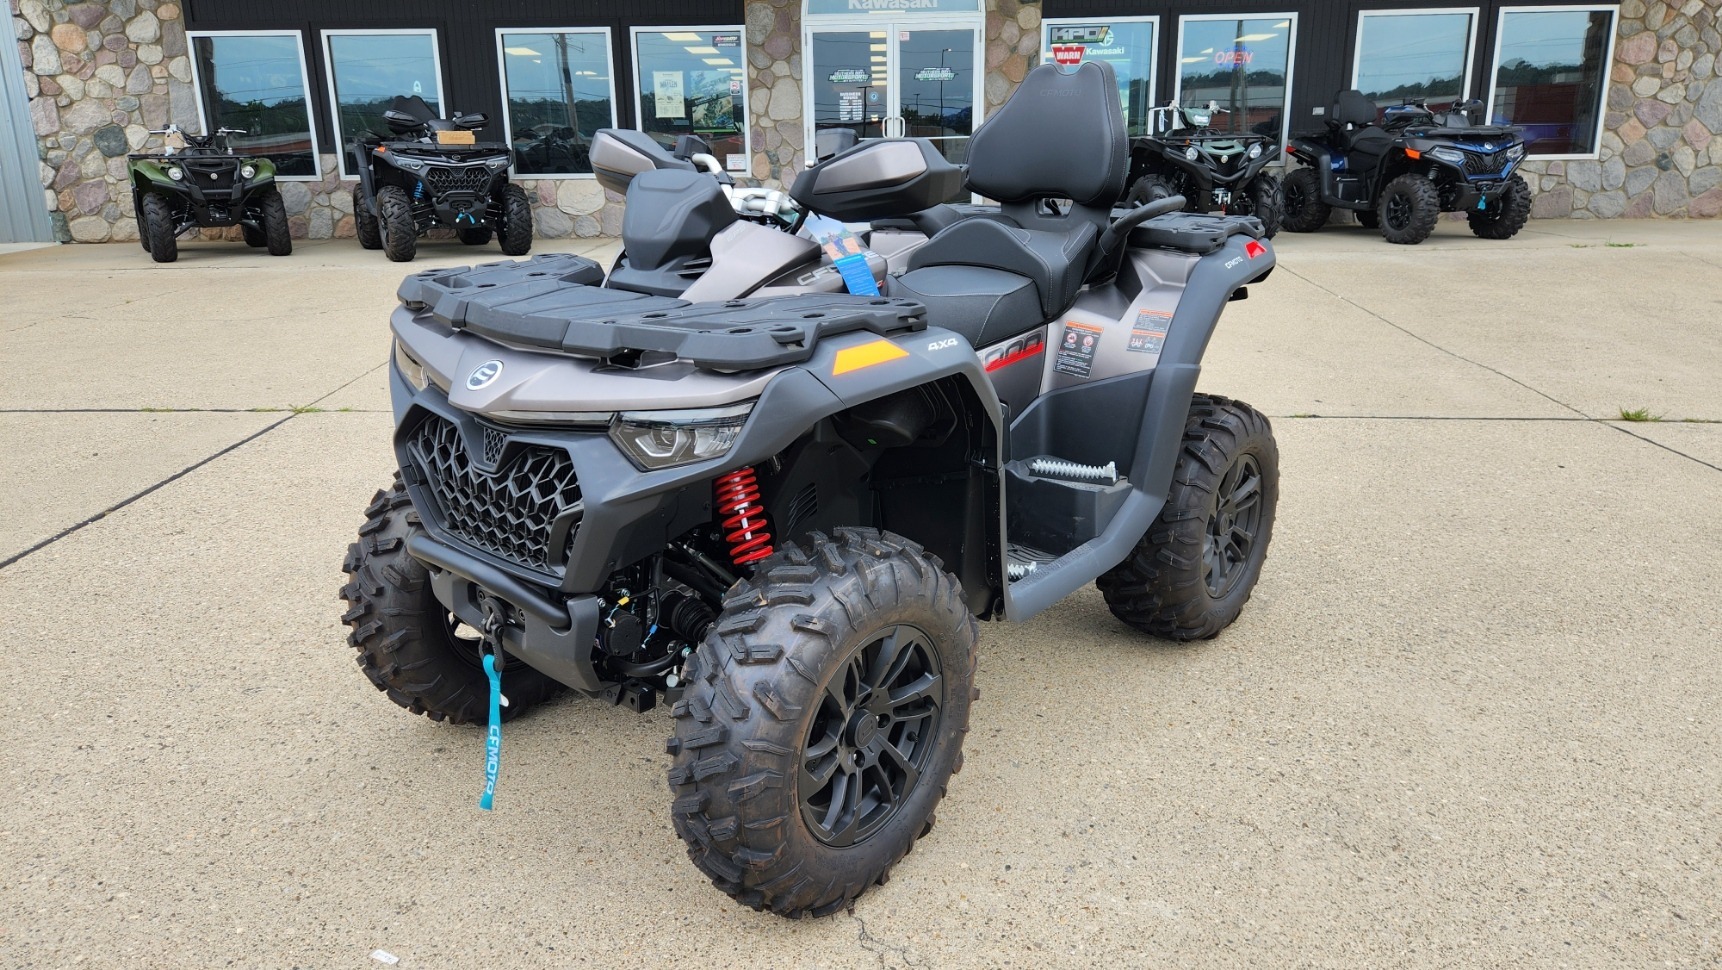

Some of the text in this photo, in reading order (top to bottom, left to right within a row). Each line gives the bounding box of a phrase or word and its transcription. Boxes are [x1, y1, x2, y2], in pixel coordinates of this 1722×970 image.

[848, 0, 938, 9] Kawasaki
[1056, 51, 1081, 60] WARN
[1086, 47, 1125, 55] Kawasaki
[1214, 51, 1254, 64] OPEN
[486, 724, 500, 795] CFMOTO
